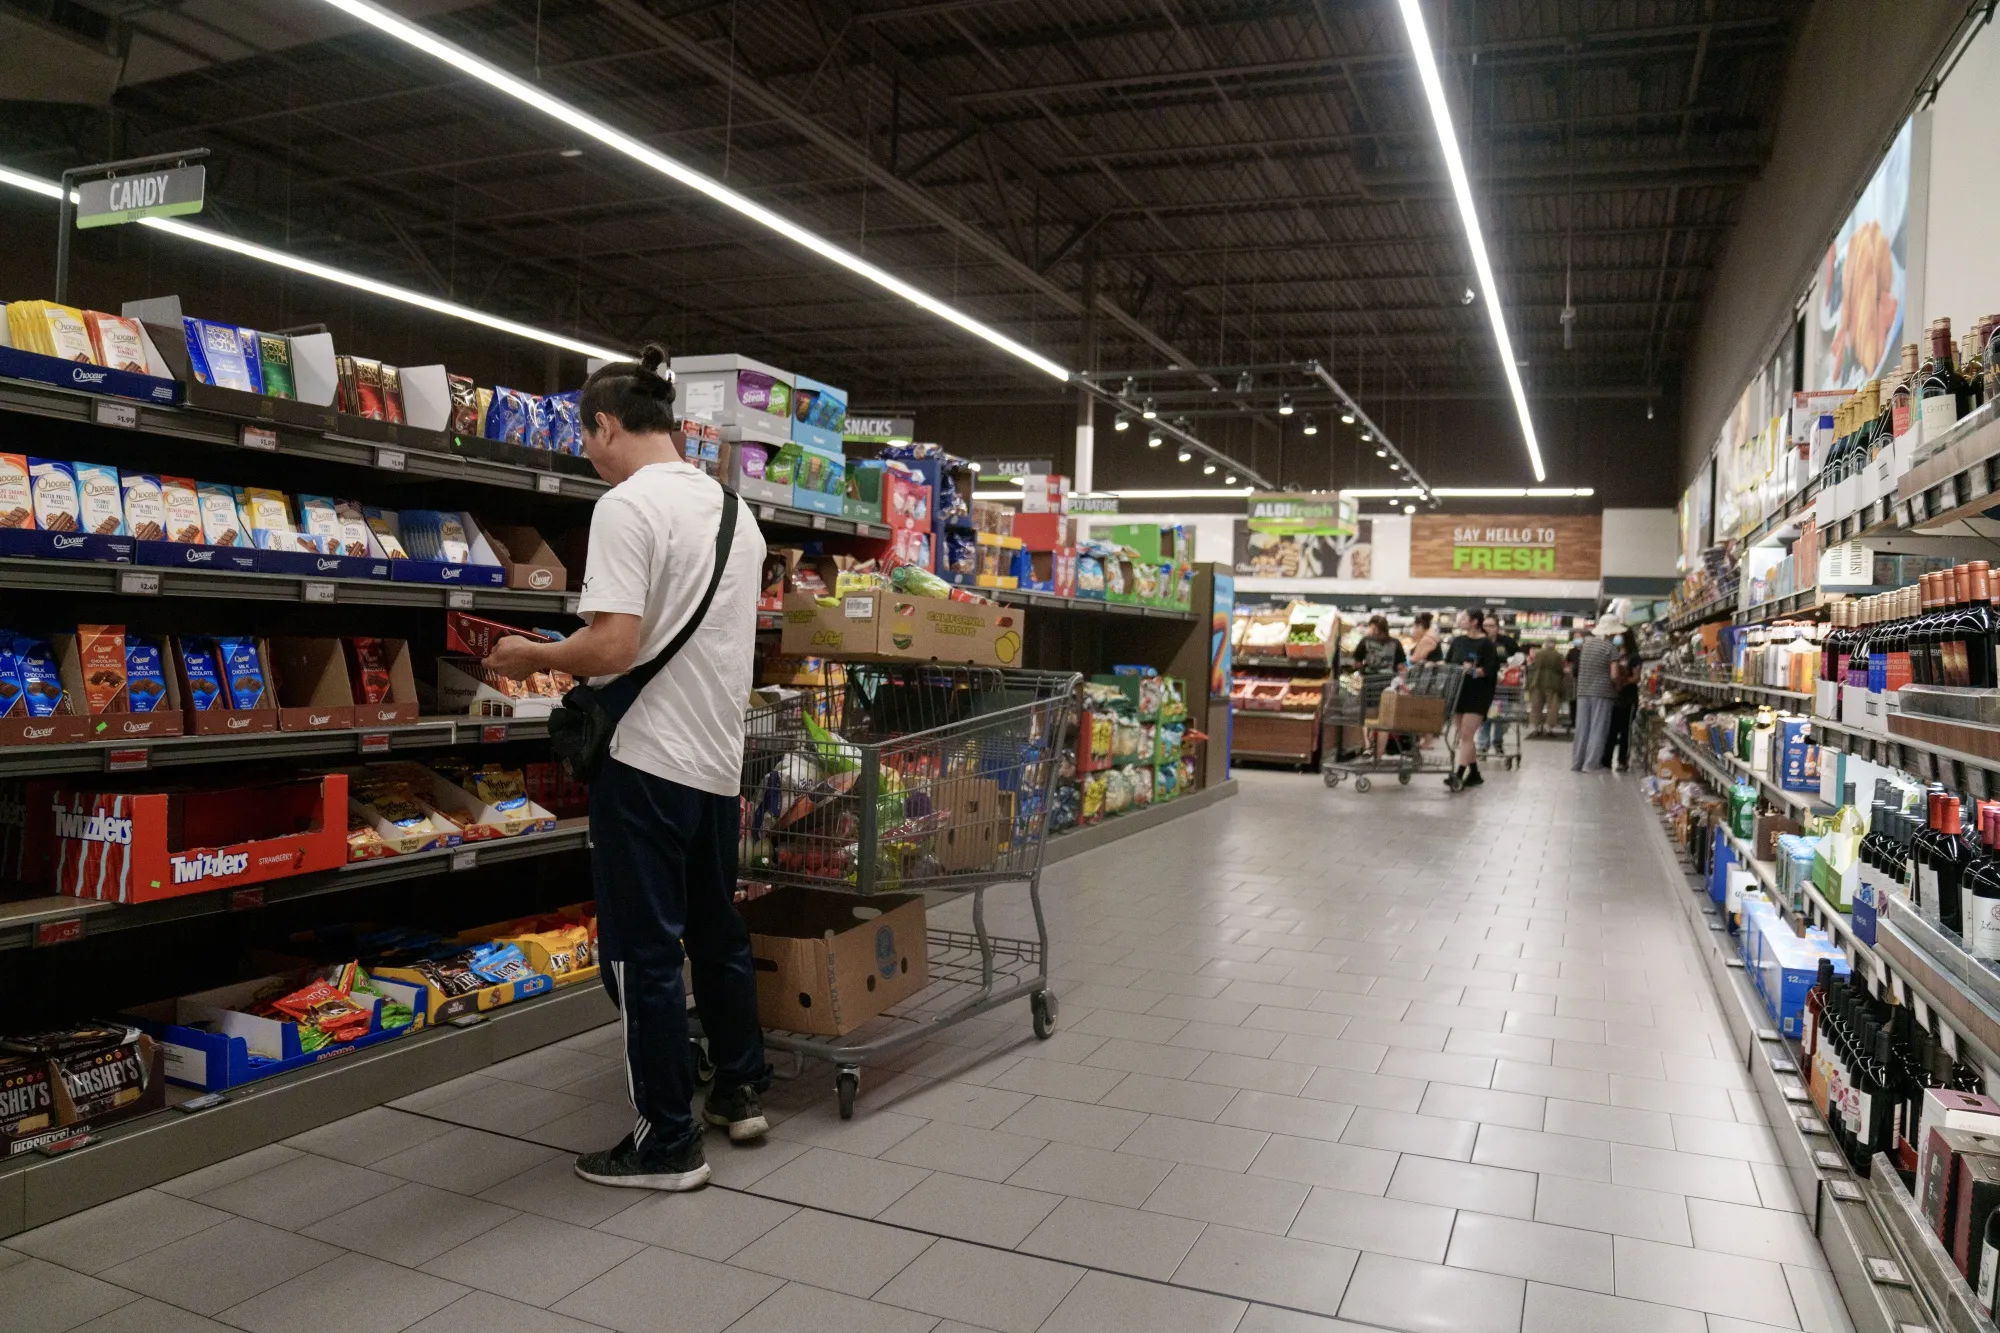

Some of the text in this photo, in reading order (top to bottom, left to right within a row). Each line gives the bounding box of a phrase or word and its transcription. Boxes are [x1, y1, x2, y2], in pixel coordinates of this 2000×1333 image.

[109, 175, 169, 212] CANDY
[72, 367, 104, 382] Choceur
[844, 419, 892, 436] SNACKS
[998, 462, 1031, 475] SALSA
[37, 477, 71, 491] Choceur
[85, 481, 116, 496] Choceur
[1068, 499, 1118, 512] PLY NATURE
[1254, 503, 1291, 517] ALDI
[53, 534, 87, 548] Choceur
[1454, 528, 1555, 542] SAY HELLO TO
[186, 548, 214, 562] Choceur
[1453, 548, 1555, 572] FRESH
[926, 611, 986, 628] CALIFORNIA
[935, 623, 976, 637] LEMONS
[23, 726, 56, 739] Choceur
[123, 720, 153, 733] Choceur
[51, 804, 133, 846] Twizzlers
[170, 848, 249, 885] Twizzlers
[258, 853, 293, 866] STRAWBERRY
[1787, 975, 1799, 983] 12
[61, 1055, 140, 1098] HERSHEY'S
[0, 1081, 51, 1118] SHEY'S
